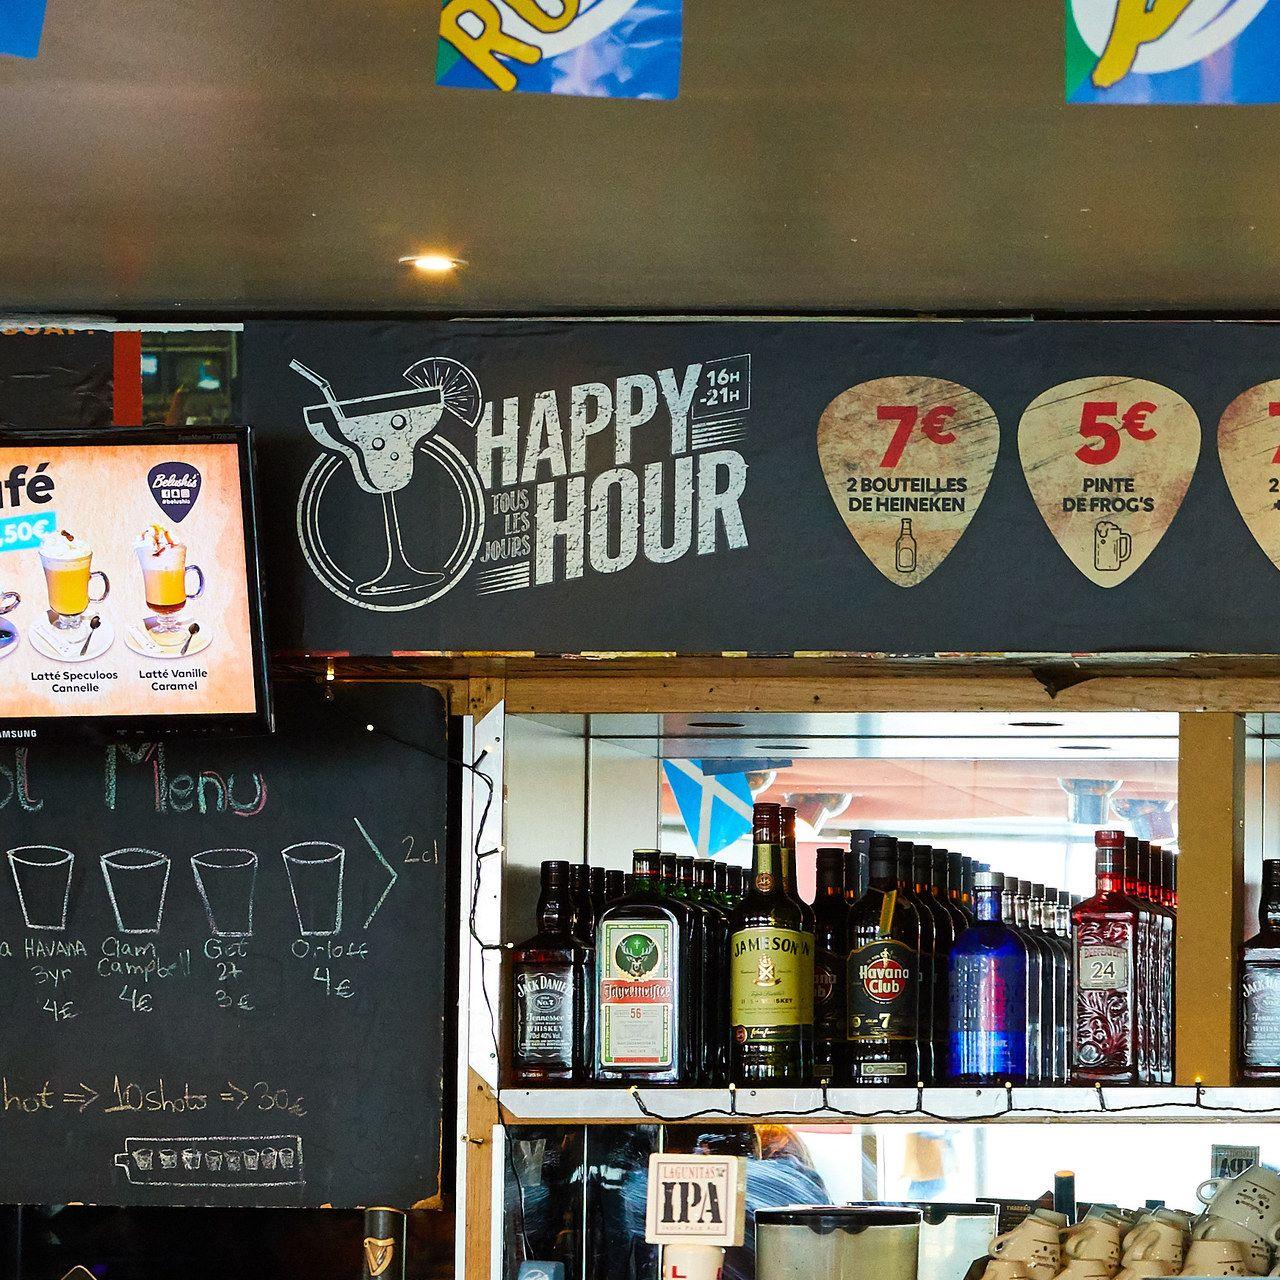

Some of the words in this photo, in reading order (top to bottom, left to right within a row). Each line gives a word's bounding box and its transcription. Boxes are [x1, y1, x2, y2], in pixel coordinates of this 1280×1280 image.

[706, 368, 740, 387] 16H
[475, 362, 703, 490] HAPPY
[1074, 401, 1157, 465] 5€
[876, 405, 957, 468] 7€
[847, 478, 857, 494] 2
[860, 478, 968, 494] BOUTEILLES
[1082, 478, 1135, 494] PINTE
[1268, 478, 1279, 494] 2
[490, 487, 530, 515] TOUS
[848, 497, 872, 513] DE
[875, 497, 966, 513] HEINEKEN
[1062, 497, 1085, 513] DE
[1086, 496, 1155, 513] FROG'S
[504, 511, 531, 536] LES
[533, 448, 750, 587] HOUR
[479, 534, 532, 563] JOURS
[31, 671, 61, 682] Latté
[63, 670, 119, 682] Speculoos
[138, 669, 169, 680] Latté
[170, 668, 209, 680] Vanille
[51, 682, 100, 693] Cannelle
[150, 680, 199, 692] Caramel
[105, 741, 268, 817] Menu
[24, 939, 88, 957] HAVANA
[859, 965, 910, 981] Havana
[1090, 961, 1116, 980] 24
[517, 979, 539, 998] JACK
[868, 977, 901, 994] Club
[630, 1008, 642, 1020] 56
[878, 1013, 890, 1029] 7
[662, 1165, 717, 1180] LAGUNITAS
[660, 1181, 723, 1225] IPA
